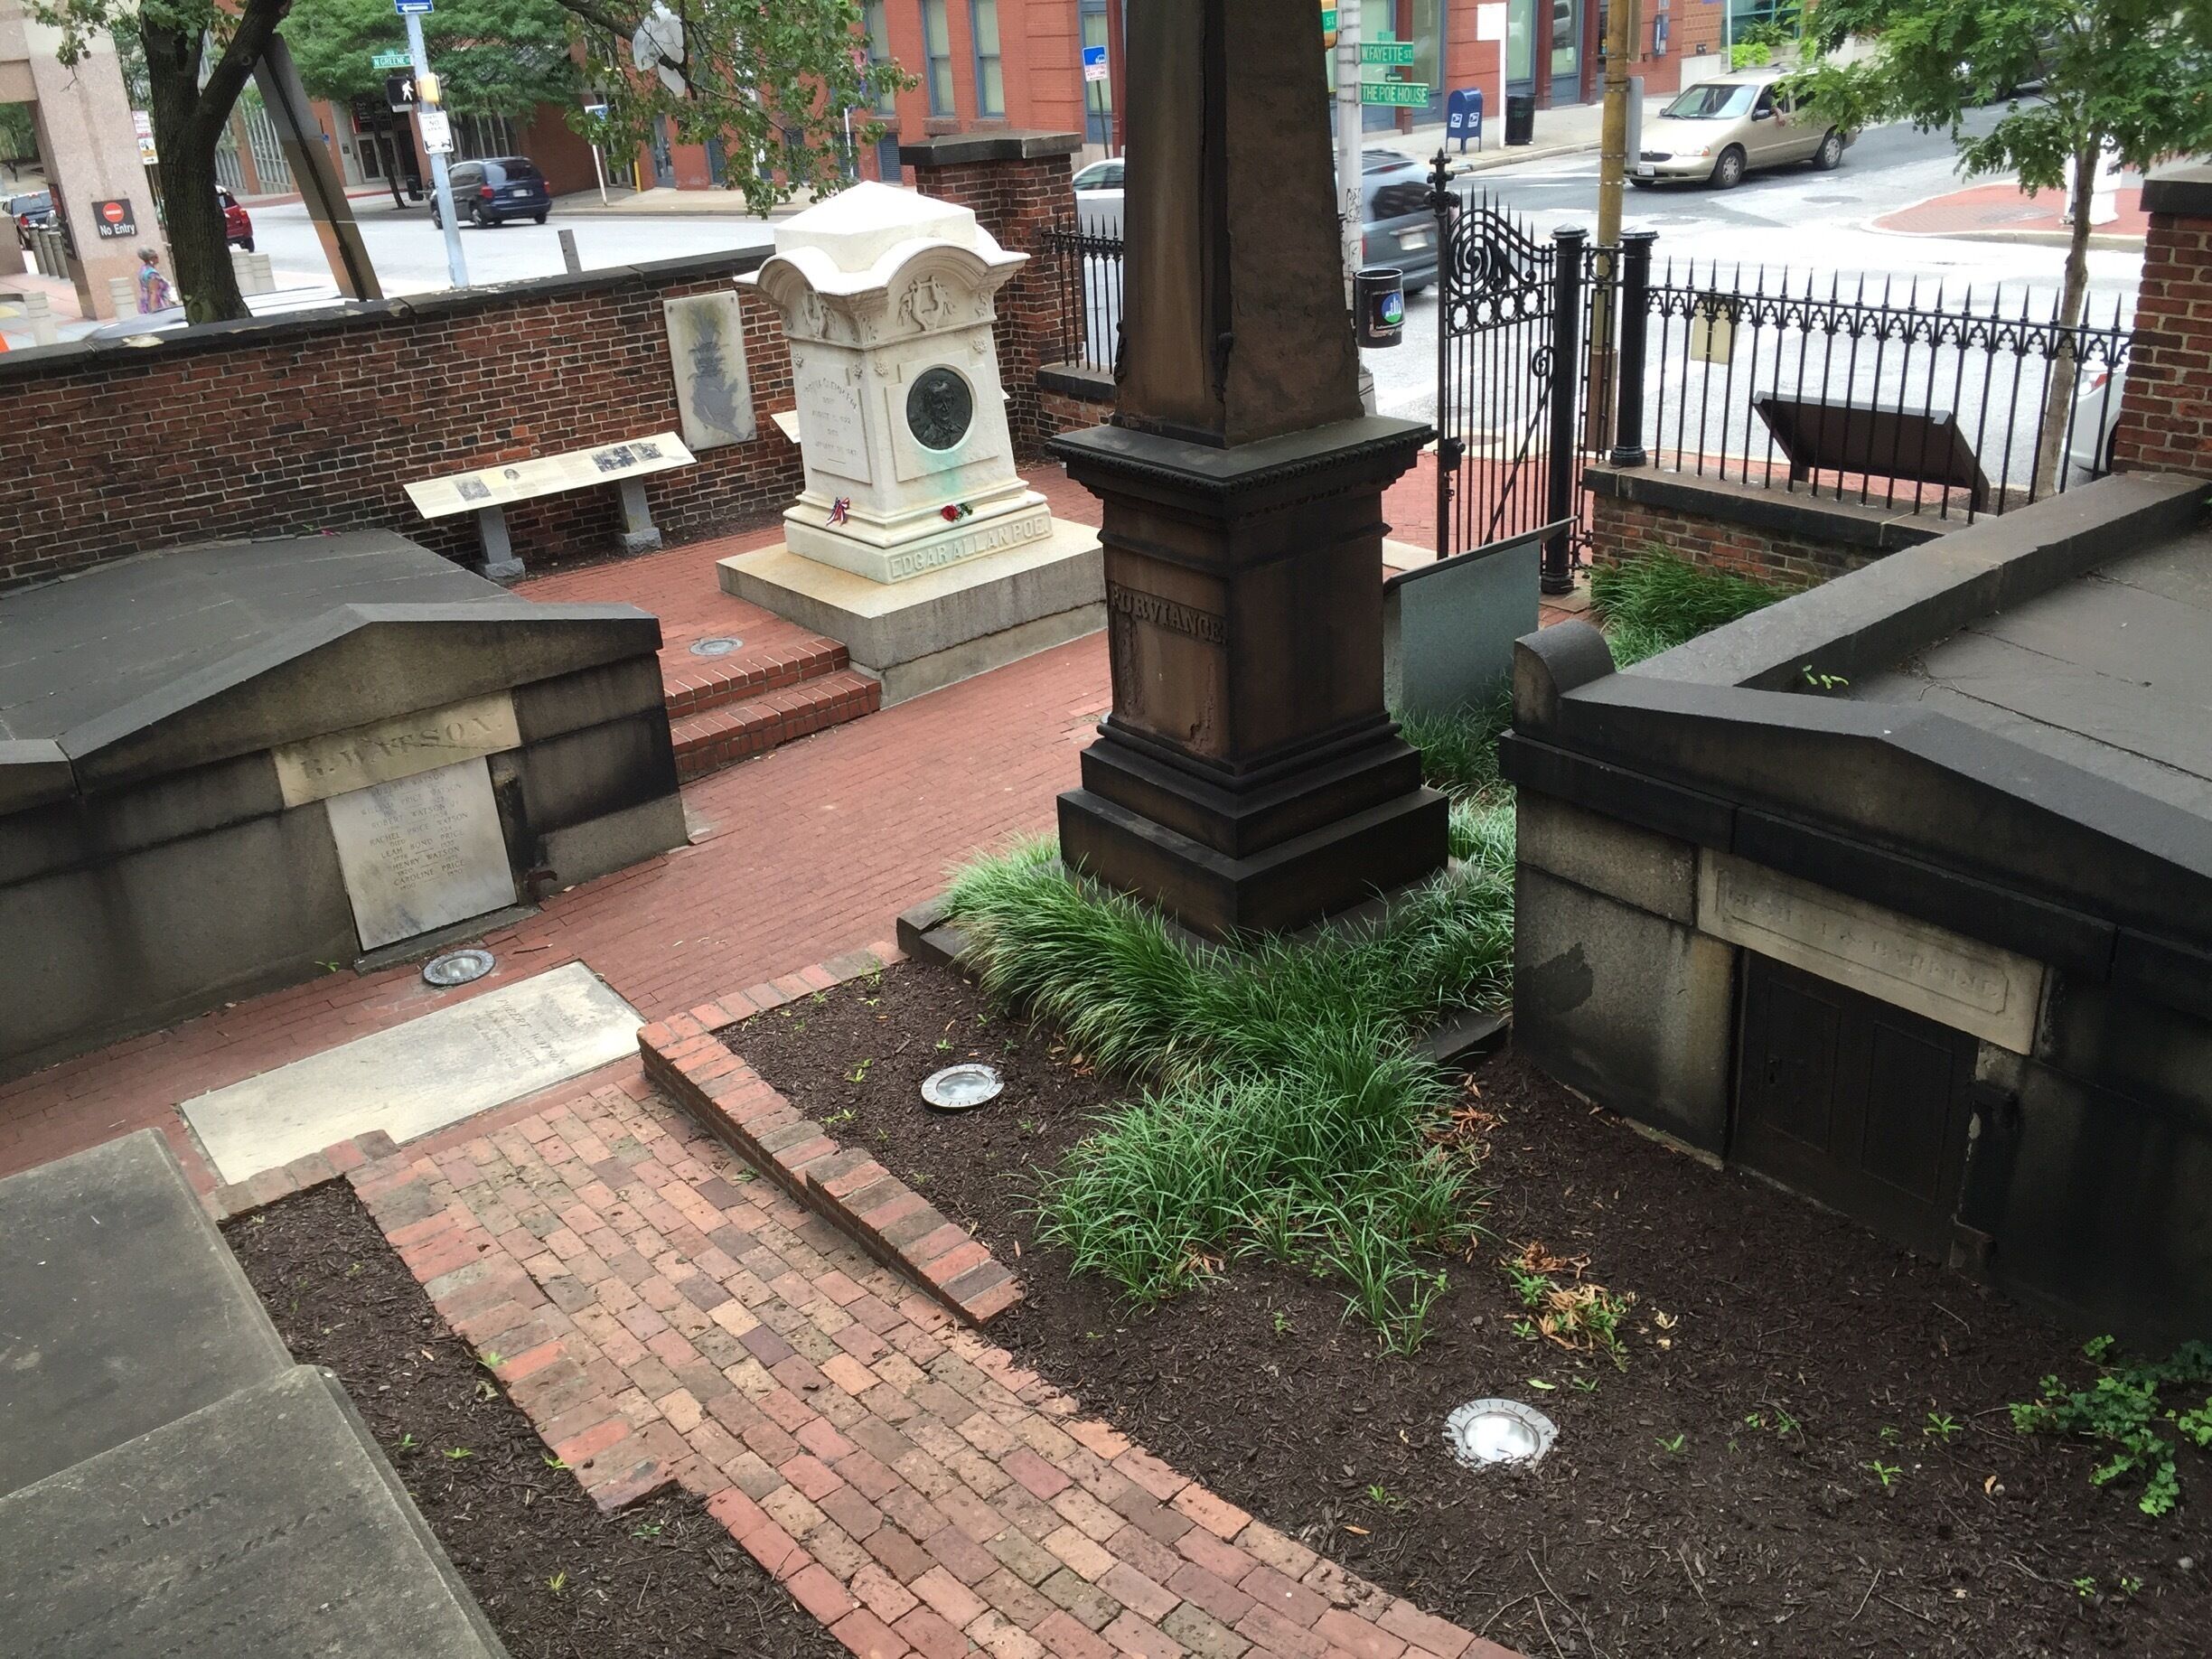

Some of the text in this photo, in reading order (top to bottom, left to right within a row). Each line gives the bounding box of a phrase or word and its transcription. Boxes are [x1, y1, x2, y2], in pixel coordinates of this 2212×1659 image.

[380, 56, 406, 66] GREENE
[1363, 85, 1428, 103] THE POE HOUSE
[99, 223, 136, 237] No Entry
[889, 545, 948, 578] EDGAR
[952, 527, 1009, 560] ALLAN
[1111, 586, 1226, 644] PURVIANCE
[411, 802, 446, 817] WATSON
[370, 832, 402, 847] RACHEL
[407, 823, 430, 835] PRICE
[436, 812, 469, 826] WATSON
[410, 838, 434, 850] BOND
[392, 846, 461, 871] HENRY WATSON
[394, 859, 466, 886] CAROLINE PRICE
